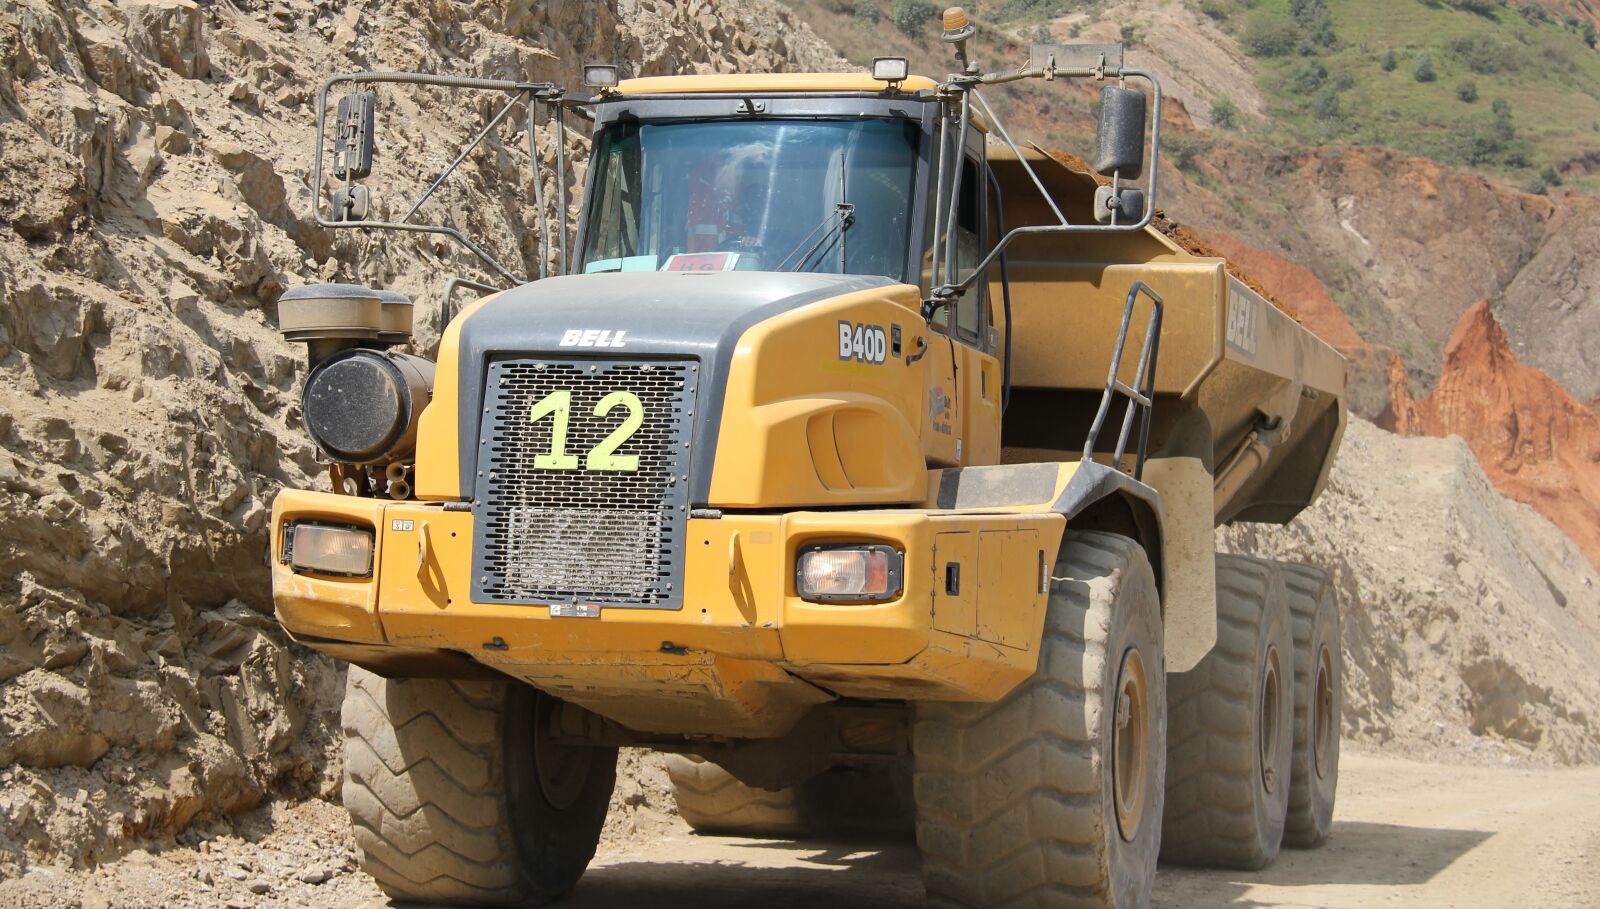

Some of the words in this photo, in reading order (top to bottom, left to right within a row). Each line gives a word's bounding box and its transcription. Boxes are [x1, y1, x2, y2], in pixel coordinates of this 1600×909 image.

[559, 329, 626, 347] BELL
[838, 321, 887, 364] B40D
[1227, 288, 1257, 354] BELL
[530, 391, 644, 471] 12
